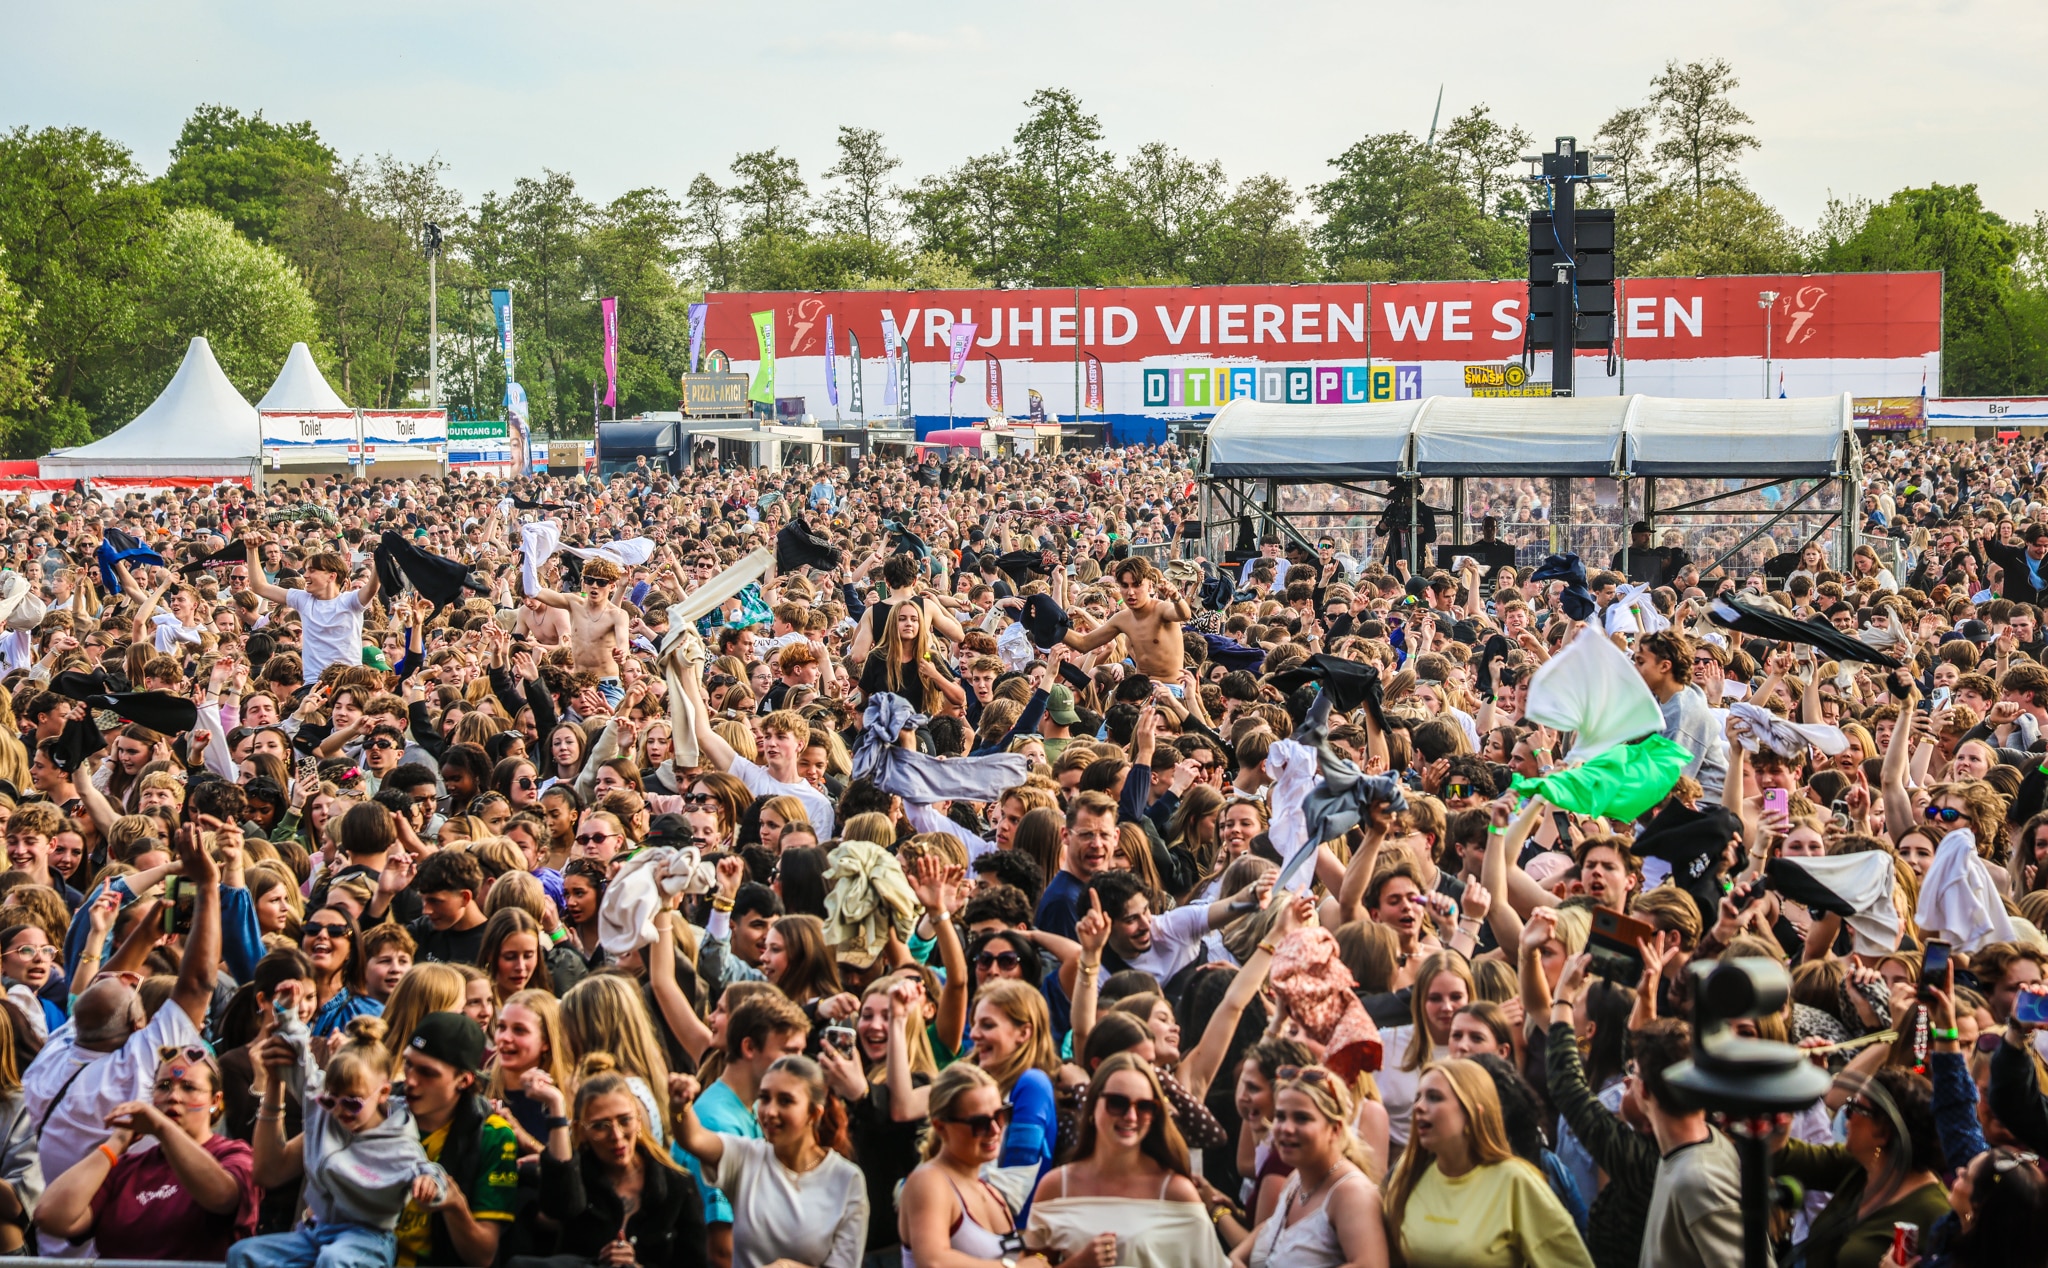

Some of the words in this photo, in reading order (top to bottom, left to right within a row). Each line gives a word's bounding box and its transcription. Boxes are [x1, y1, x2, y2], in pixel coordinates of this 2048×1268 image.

[1155, 303, 1364, 346] VIEREN
[1383, 300, 1473, 342] WE
[1491, 296, 1702, 341] SEN
[1465, 371, 1504, 386] SMASH
[1148, 373, 1206, 402] DIT
[1989, 404, 2010, 414] Bar
[299, 420, 322, 437] Toilet
[396, 420, 416, 435] Toilet
[447, 427, 490, 436] DUITGANG
